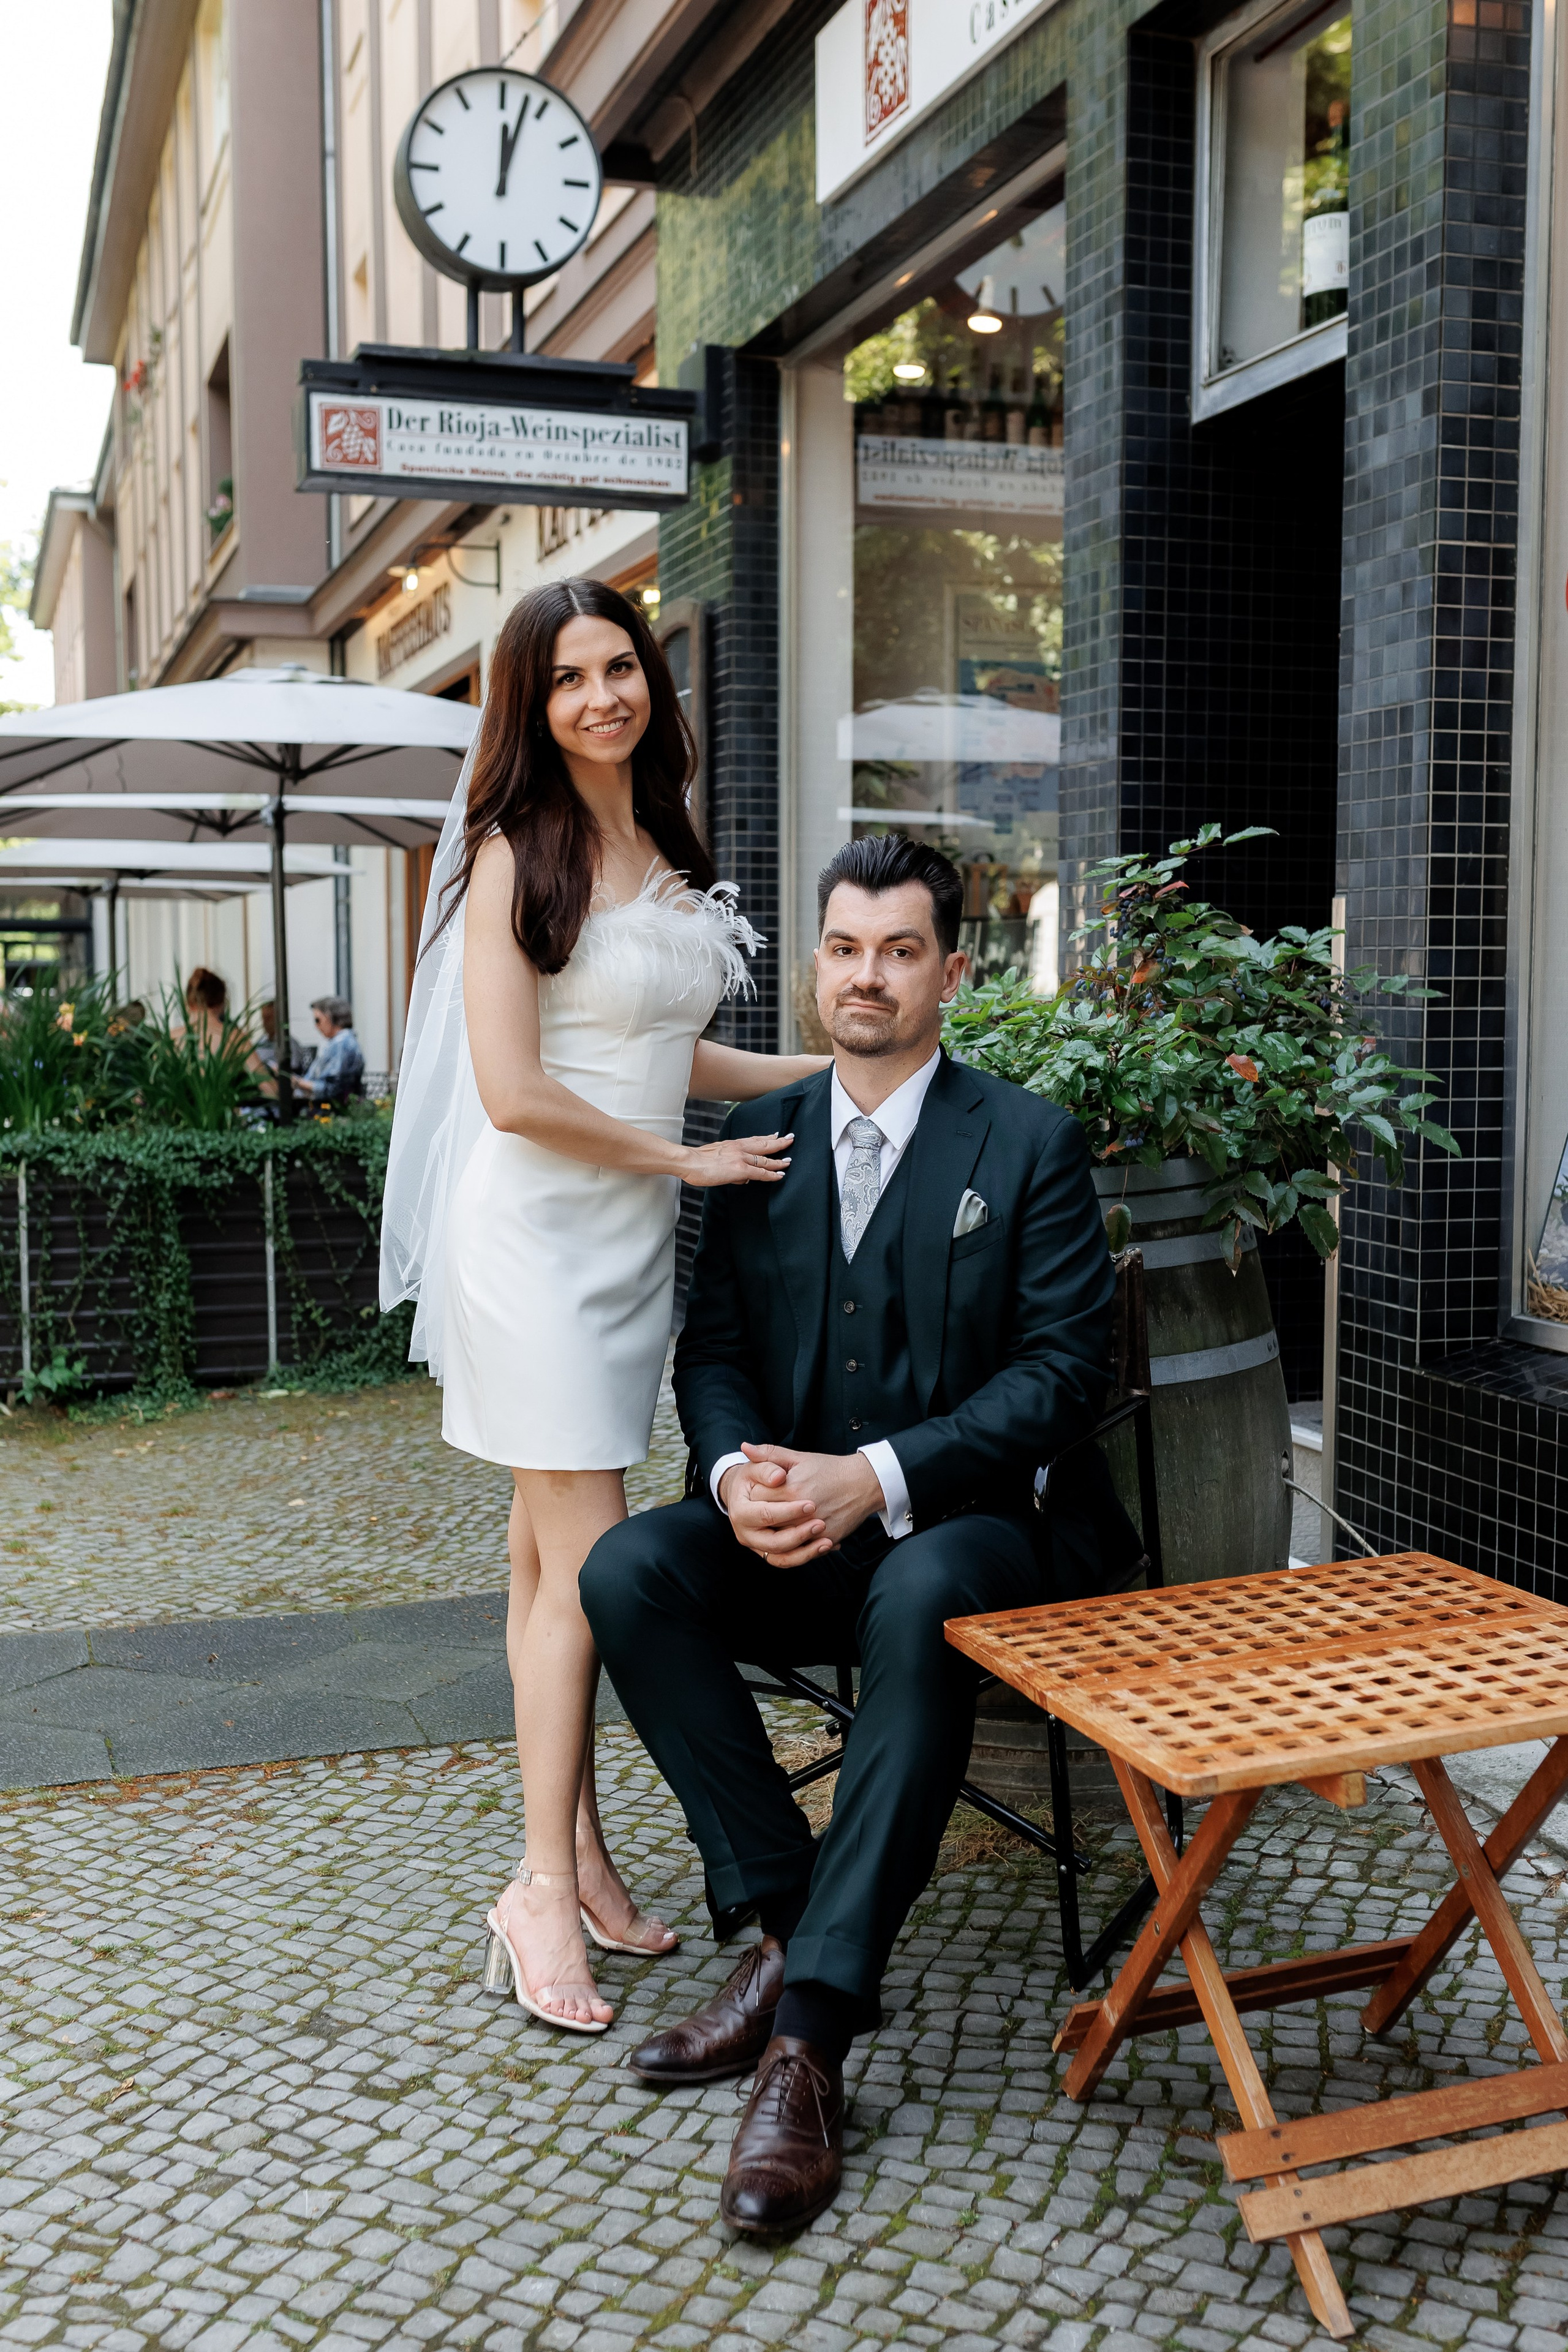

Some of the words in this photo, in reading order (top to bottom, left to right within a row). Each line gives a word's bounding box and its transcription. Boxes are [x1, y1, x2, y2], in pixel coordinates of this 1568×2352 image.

[970, 0, 1023, 43] Cas
[388, 407, 430, 431] Der
[439, 410, 680, 448] Rioja-Weinspezialist
[387, 440, 426, 453] Casa
[435, 442, 506, 458] fundada
[515, 451, 533, 459] en
[619, 453, 637, 464] de
